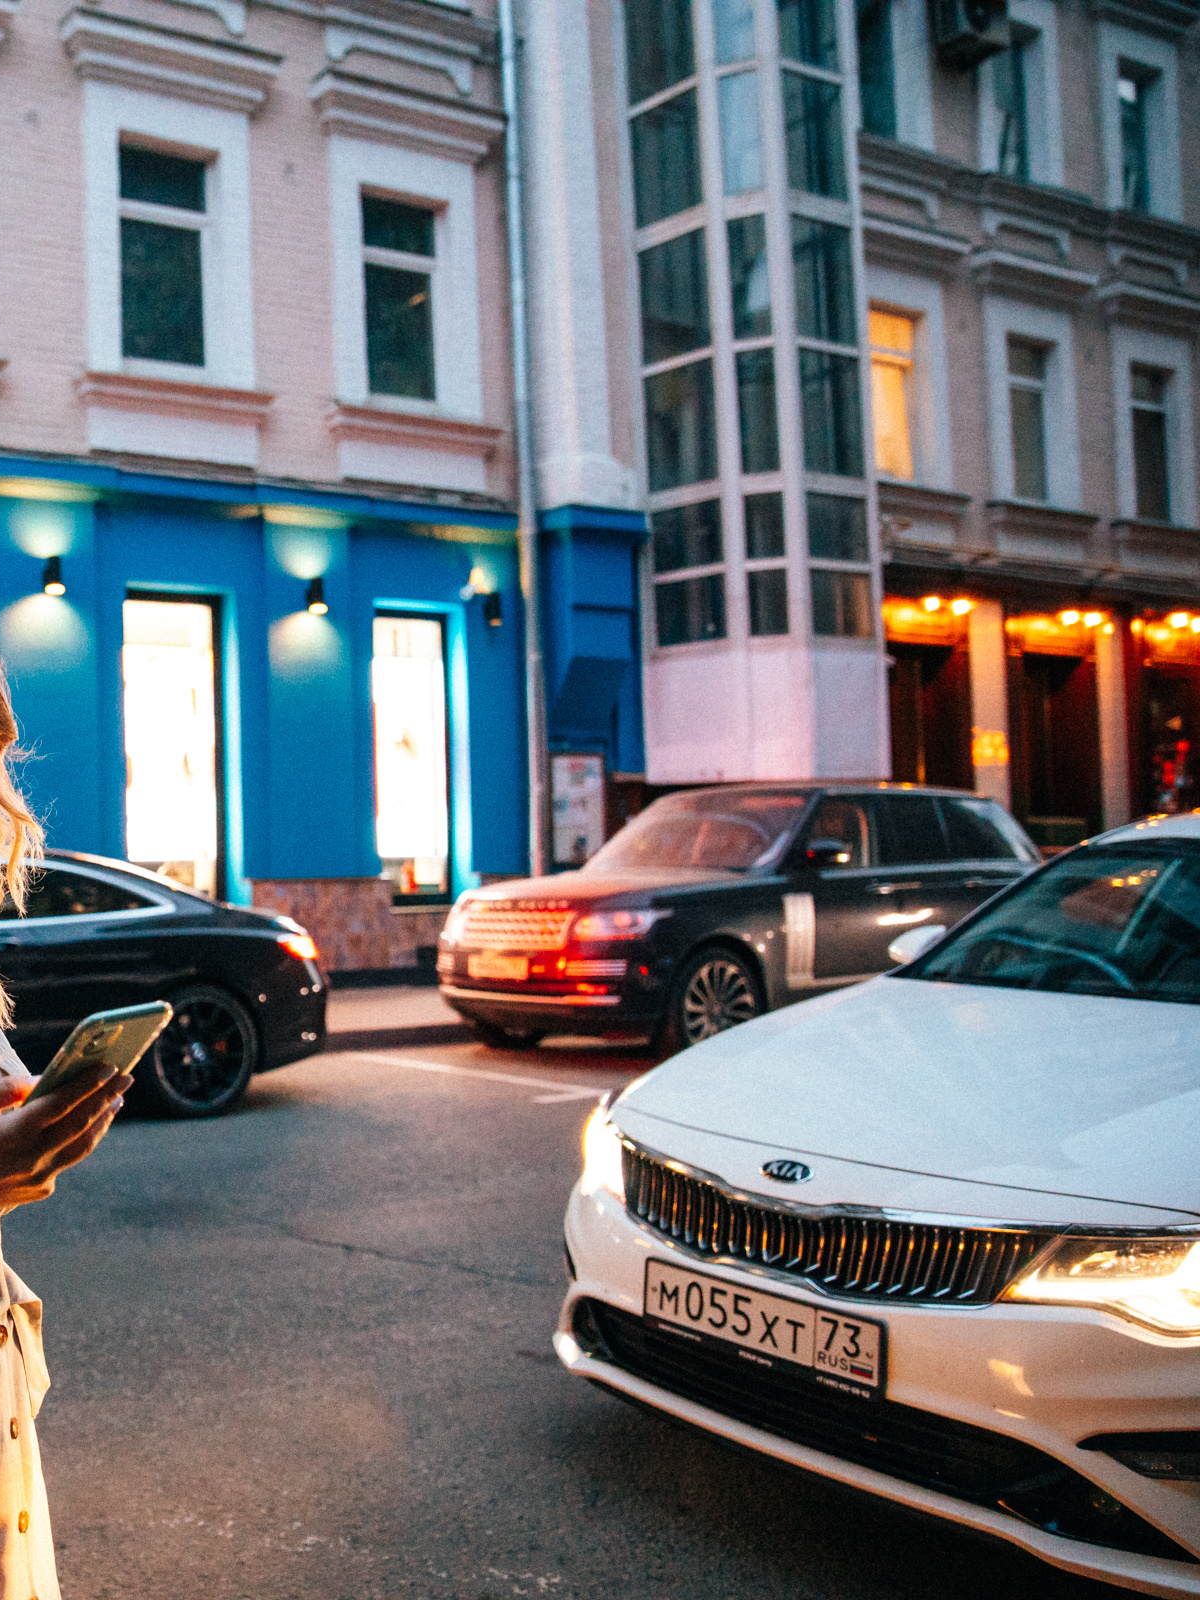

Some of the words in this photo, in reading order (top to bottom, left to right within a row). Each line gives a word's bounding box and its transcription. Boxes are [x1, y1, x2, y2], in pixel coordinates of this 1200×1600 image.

[766, 1162, 804, 1180] KIA
[821, 1316, 861, 1358] 73
[817, 1351, 849, 1371] RUS
